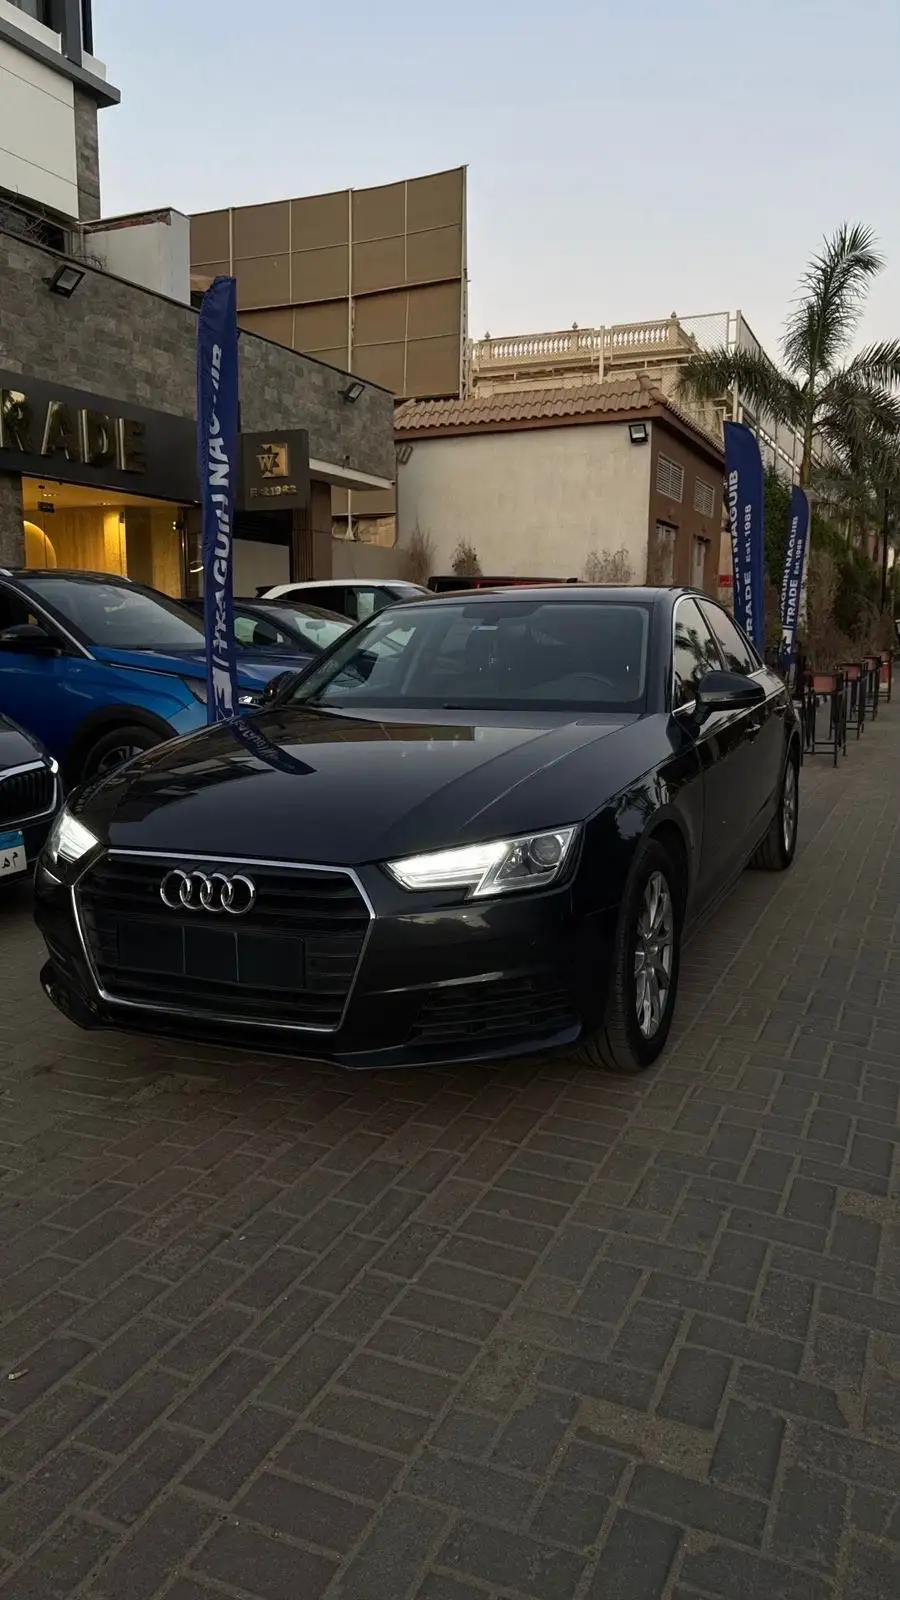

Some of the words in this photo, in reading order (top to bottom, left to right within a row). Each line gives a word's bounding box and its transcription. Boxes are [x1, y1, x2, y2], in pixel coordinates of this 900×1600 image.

[744, 504, 752, 536] 1988
[785, 516, 799, 567] NAGUIB
[786, 579, 799, 624] TRADE
